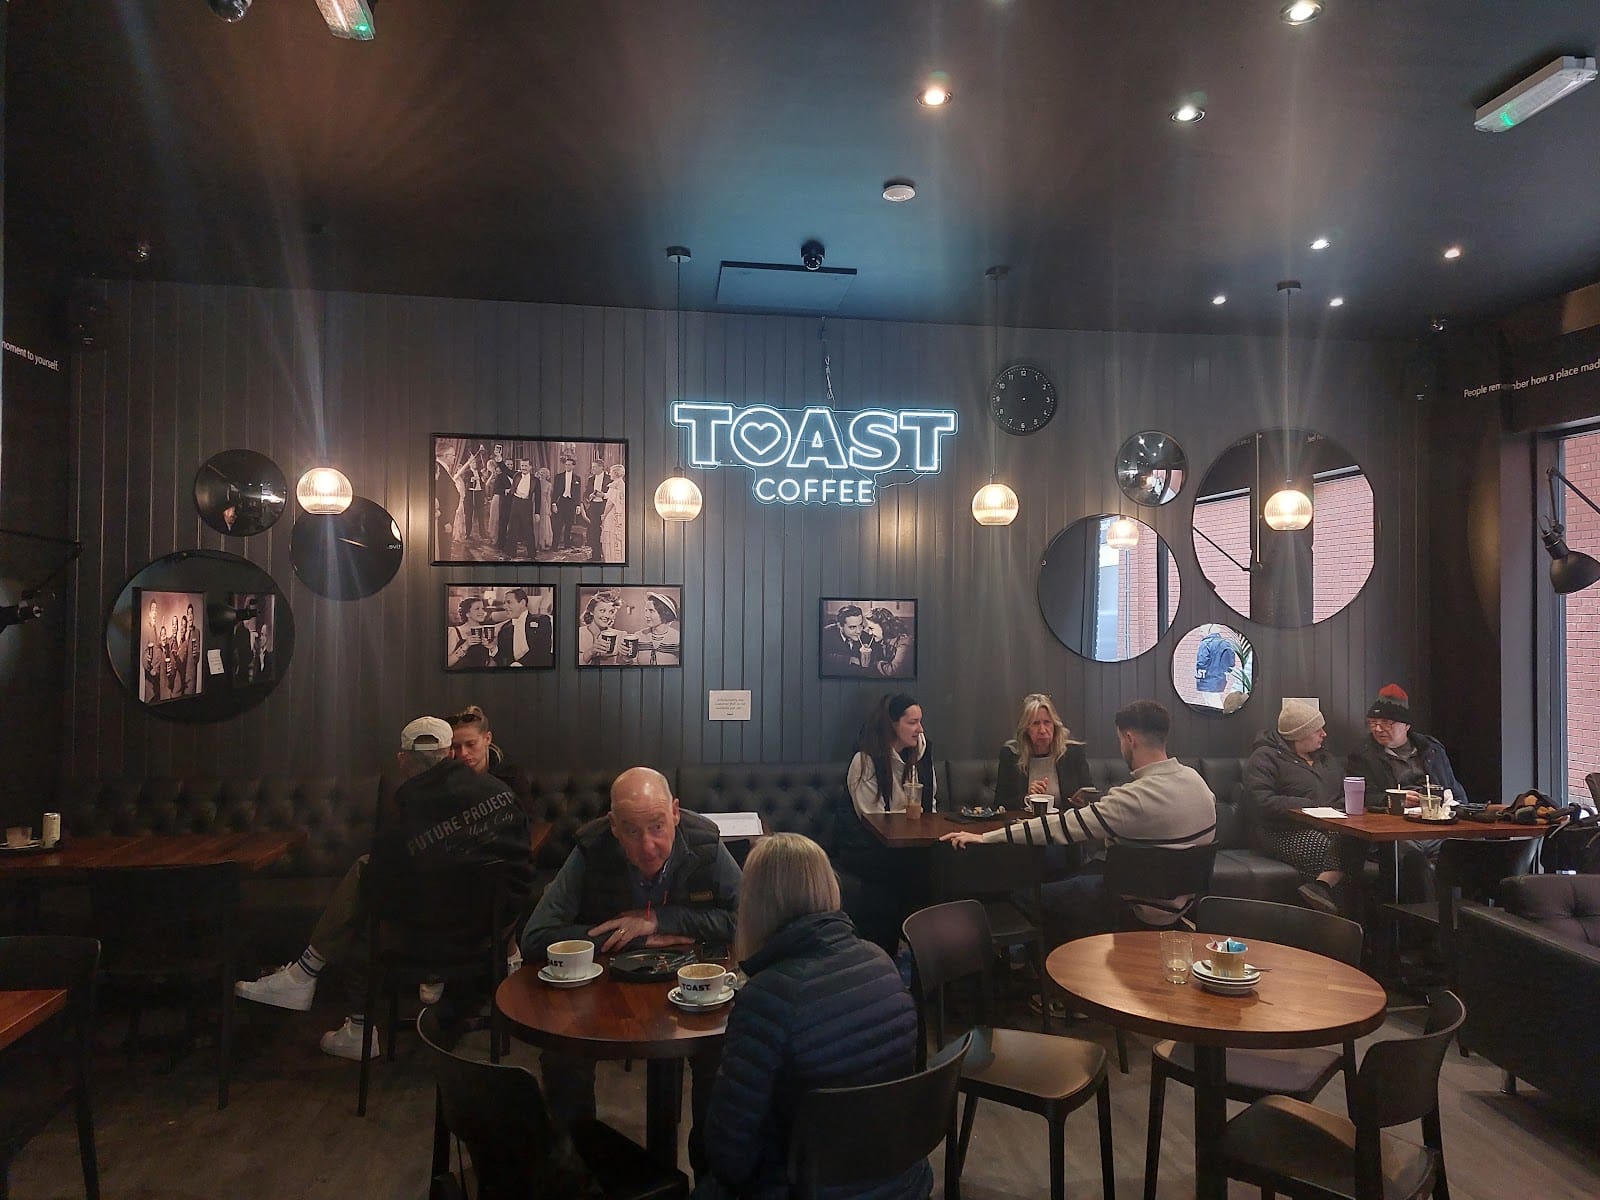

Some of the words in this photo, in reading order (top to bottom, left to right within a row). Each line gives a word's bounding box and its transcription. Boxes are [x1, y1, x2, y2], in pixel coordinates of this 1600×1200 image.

[27, 350, 34, 361] to
[1463, 385, 1488, 398] People
[1488, 380, 1529, 392] rember
[1530, 376, 1548, 386] how
[1549, 373, 1554, 381] a
[1556, 367, 1579, 381] place
[674, 404, 955, 470] TOAST
[756, 478, 874, 503] COFFEE
[407, 816, 462, 857] FUTURE
